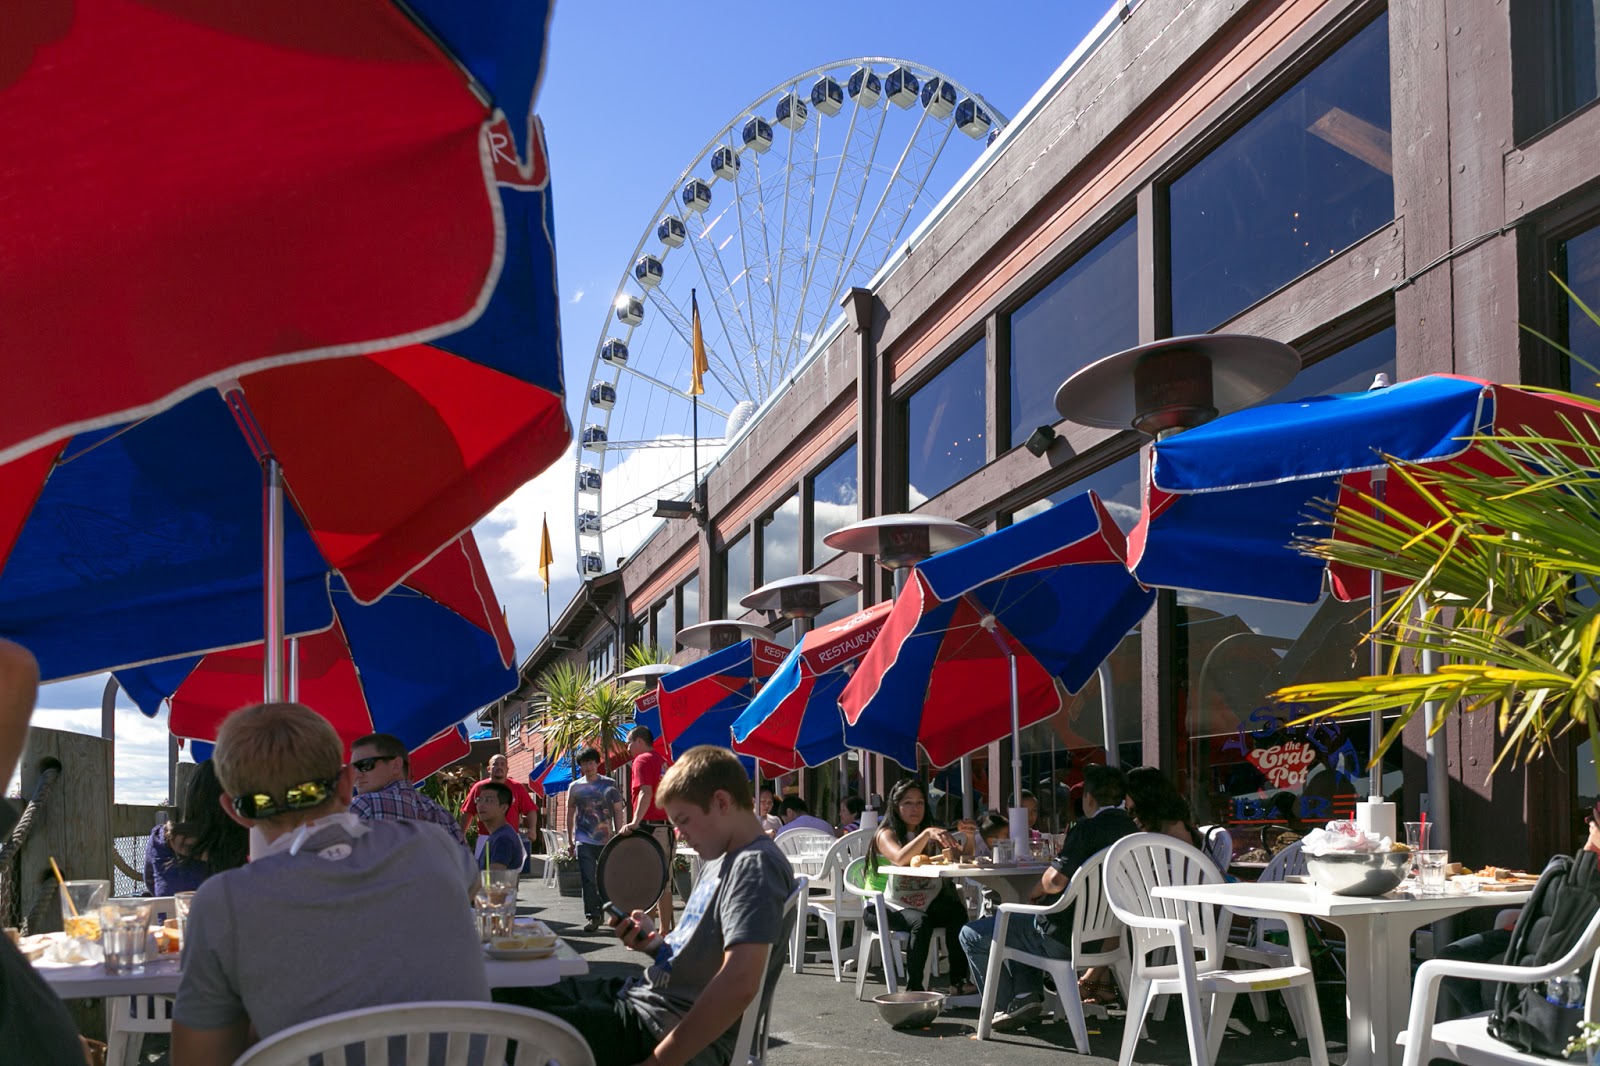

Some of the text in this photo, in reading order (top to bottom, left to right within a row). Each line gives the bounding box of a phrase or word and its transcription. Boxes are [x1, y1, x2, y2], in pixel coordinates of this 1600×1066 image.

[1251, 743, 1316, 769] Crab
[1285, 740, 1301, 750] the
[1268, 764, 1309, 789] Pot
